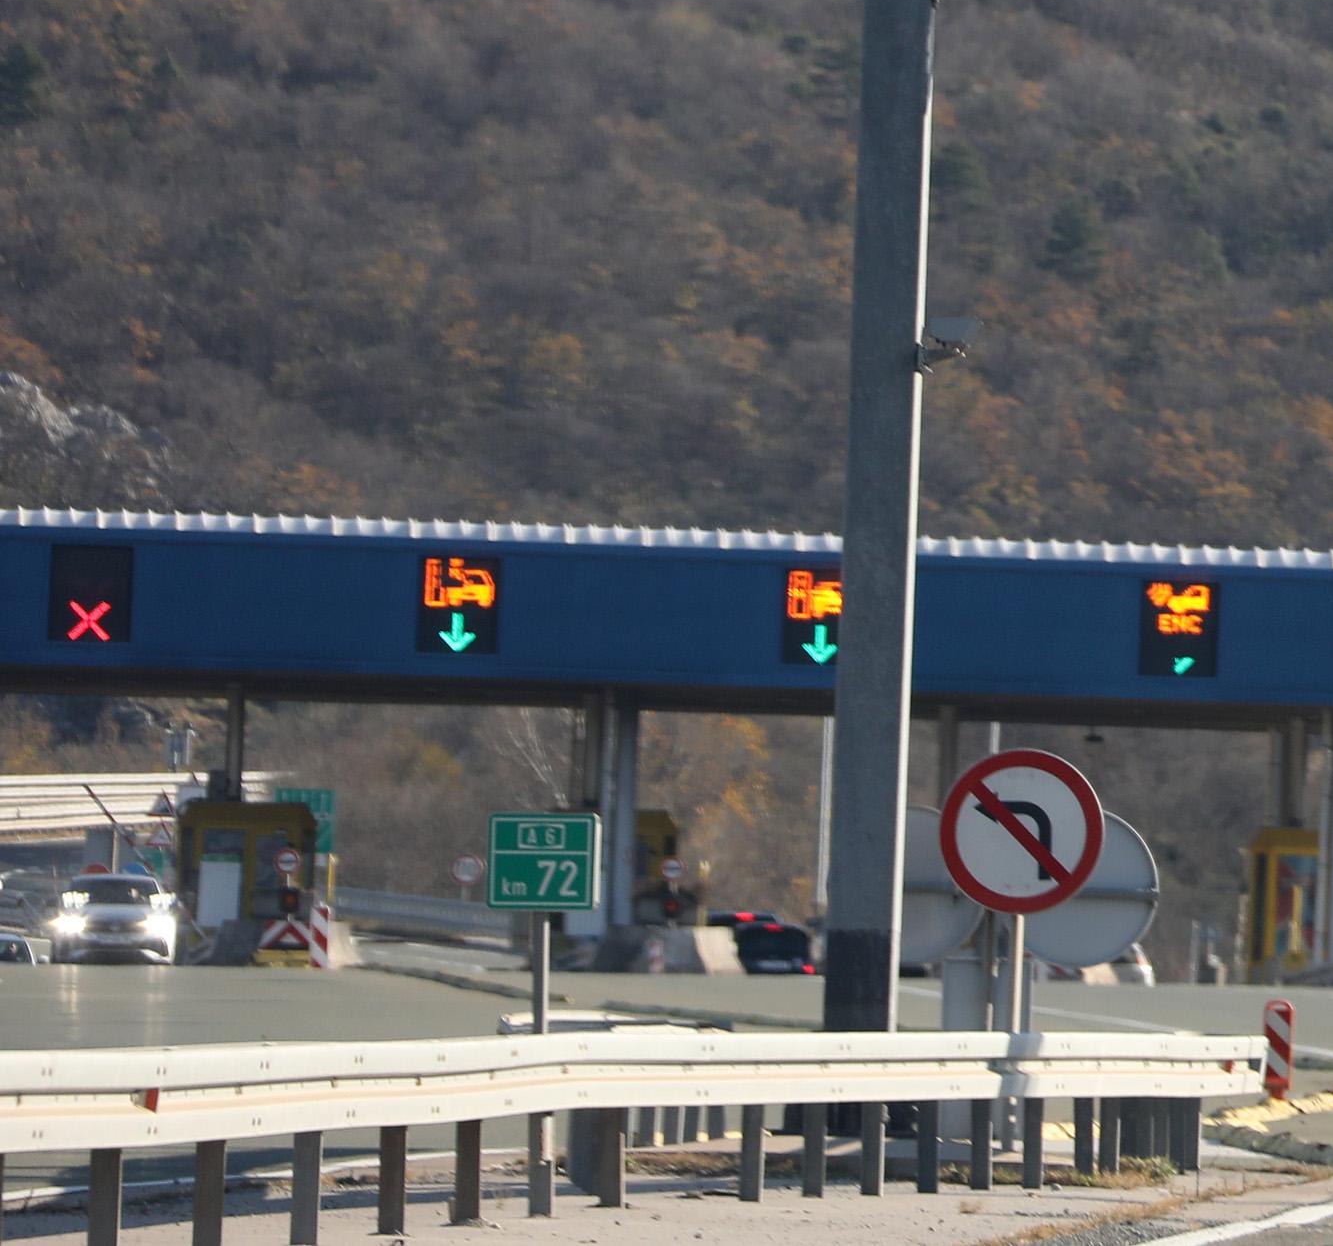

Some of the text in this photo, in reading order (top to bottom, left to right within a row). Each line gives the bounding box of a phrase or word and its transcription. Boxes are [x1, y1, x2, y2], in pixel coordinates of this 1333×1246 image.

[1157, 613, 1204, 635] ENC
[502, 859, 579, 896] km 72
